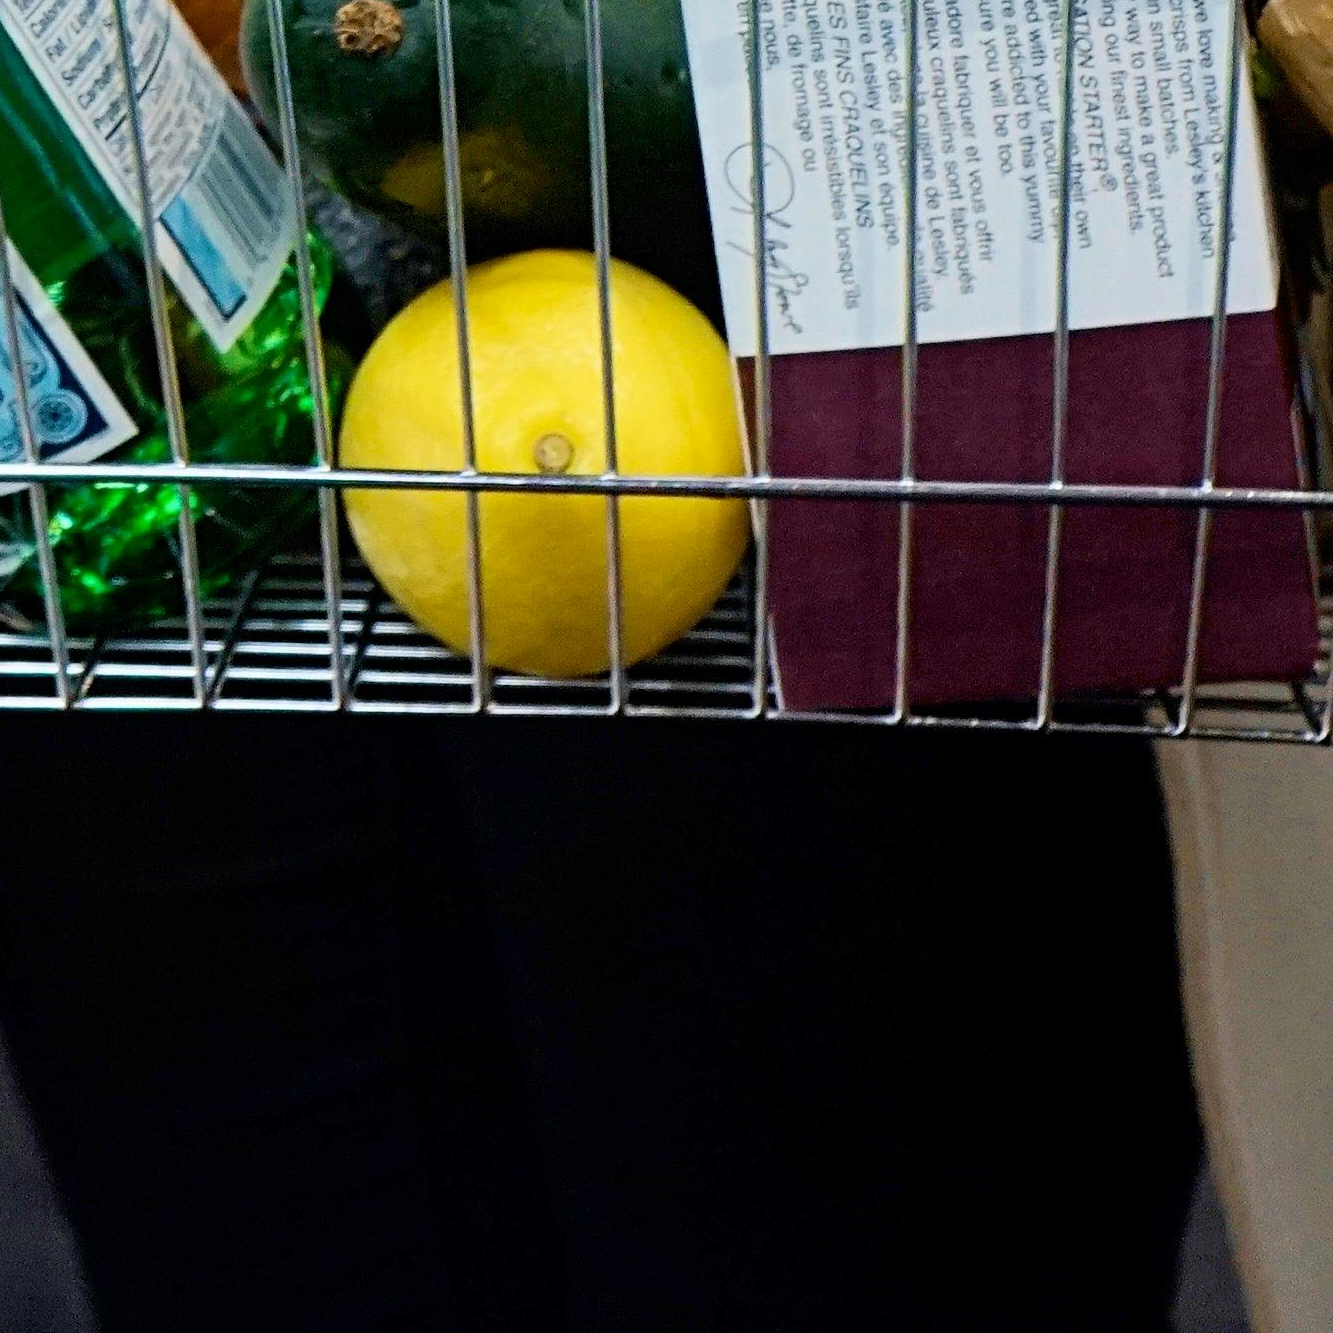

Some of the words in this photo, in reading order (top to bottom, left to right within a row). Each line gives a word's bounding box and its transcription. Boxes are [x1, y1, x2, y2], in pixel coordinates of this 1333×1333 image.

[785, 33, 802, 57] de
[878, 18, 897, 63] avec
[1027, 27, 1048, 67] with
[1122, 7, 1143, 46] way
[1147, 20, 1171, 73] small
[830, 34, 854, 85] FINS
[978, 36, 999, 73] you
[1003, 23, 1031, 105] addicted
[1104, 32, 1121, 64] our
[1129, 50, 1147, 70] to
[1196, 28, 1214, 68] love
[812, 68, 835, 109] sont
[860, 50, 881, 112] Lesley
[885, 68, 903, 105] des
[951, 54, 976, 141] fabriquer
[987, 76, 1008, 107] will
[1028, 71, 1051, 115] your
[1109, 69, 1132, 121] finest
[1176, 57, 1196, 102] from
[789, 62, 811, 142] fromage
[929, 55, 956, 155] craquelins
[1015, 111, 1033, 131] to
[1132, 74, 1155, 128] make
[1202, 74, 1225, 145] making
[869, 117, 887, 136] et
[992, 113, 1010, 138] be
[1140, 133, 1156, 146] a
[801, 147, 816, 172] ou
[838, 89, 874, 229] CRAQUELINS
[872, 141, 889, 176] son
[962, 145, 983, 164] et
[1018, 134, 1038, 169] this
[943, 160, 965, 201] sont
[966, 168, 986, 214] vous
[1137, 150, 1166, 201] great
[922, 185, 941, 210] de
[1018, 173, 1046, 246] yummy
[1073, 209, 1093, 249] own
[1145, 205, 1176, 278] product
[949, 206, 976, 295] fabriqués
